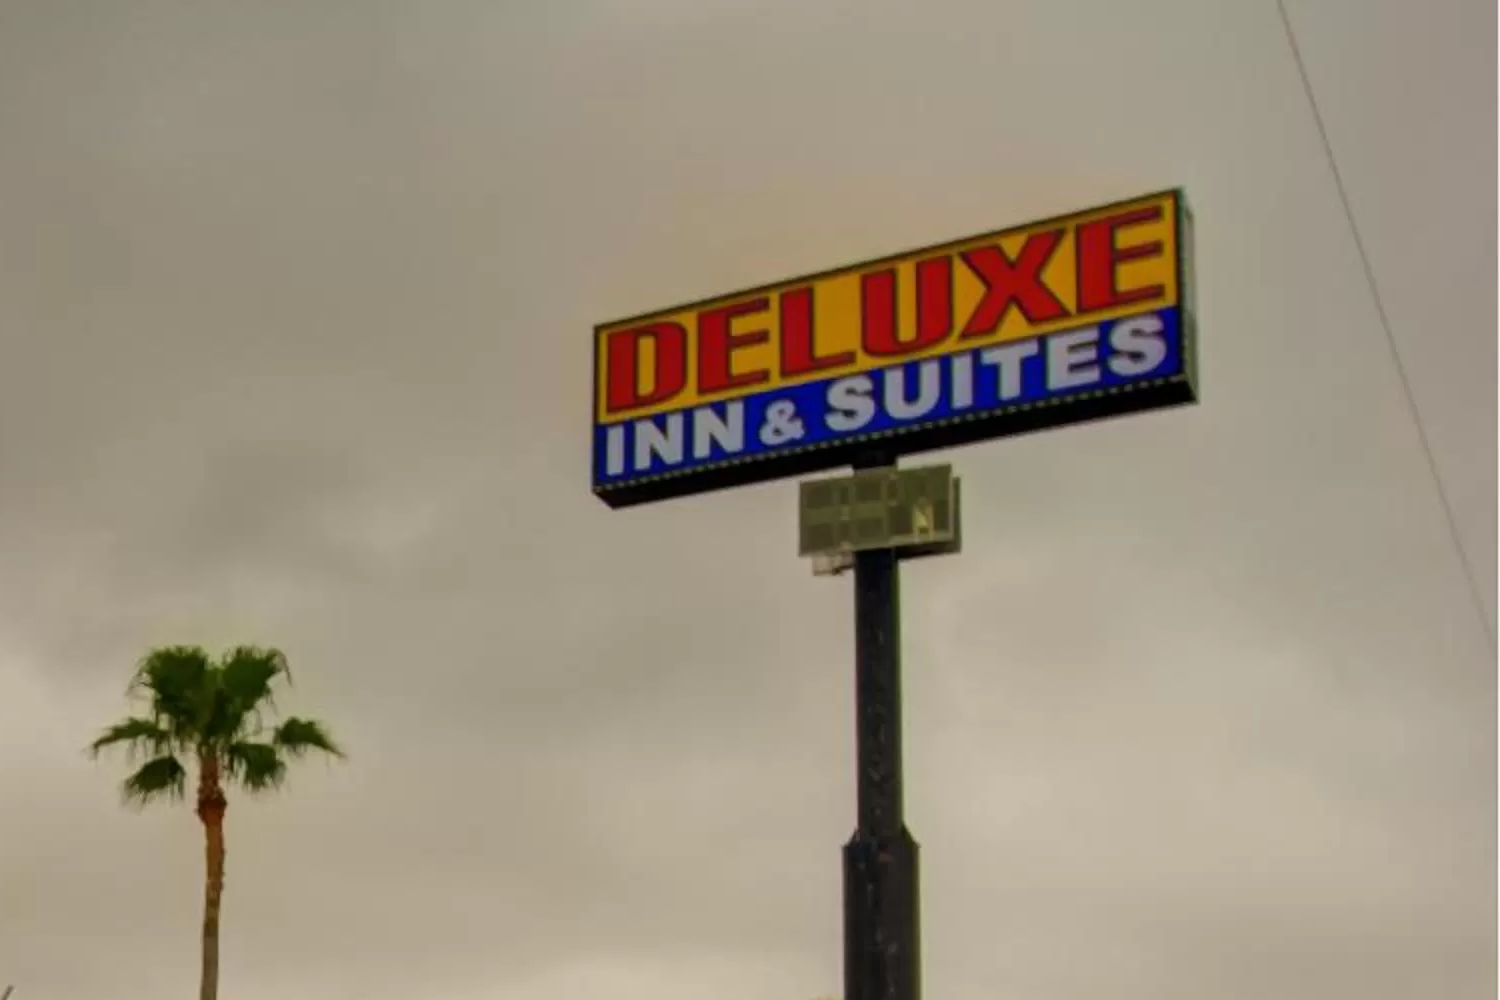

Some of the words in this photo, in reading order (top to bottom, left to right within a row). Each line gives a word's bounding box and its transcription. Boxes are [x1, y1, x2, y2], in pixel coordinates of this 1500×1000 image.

[604, 401, 745, 476] INN
[758, 399, 805, 446] &
[824, 313, 1168, 434] SUITES
[606, 204, 1164, 414] DELUXE
